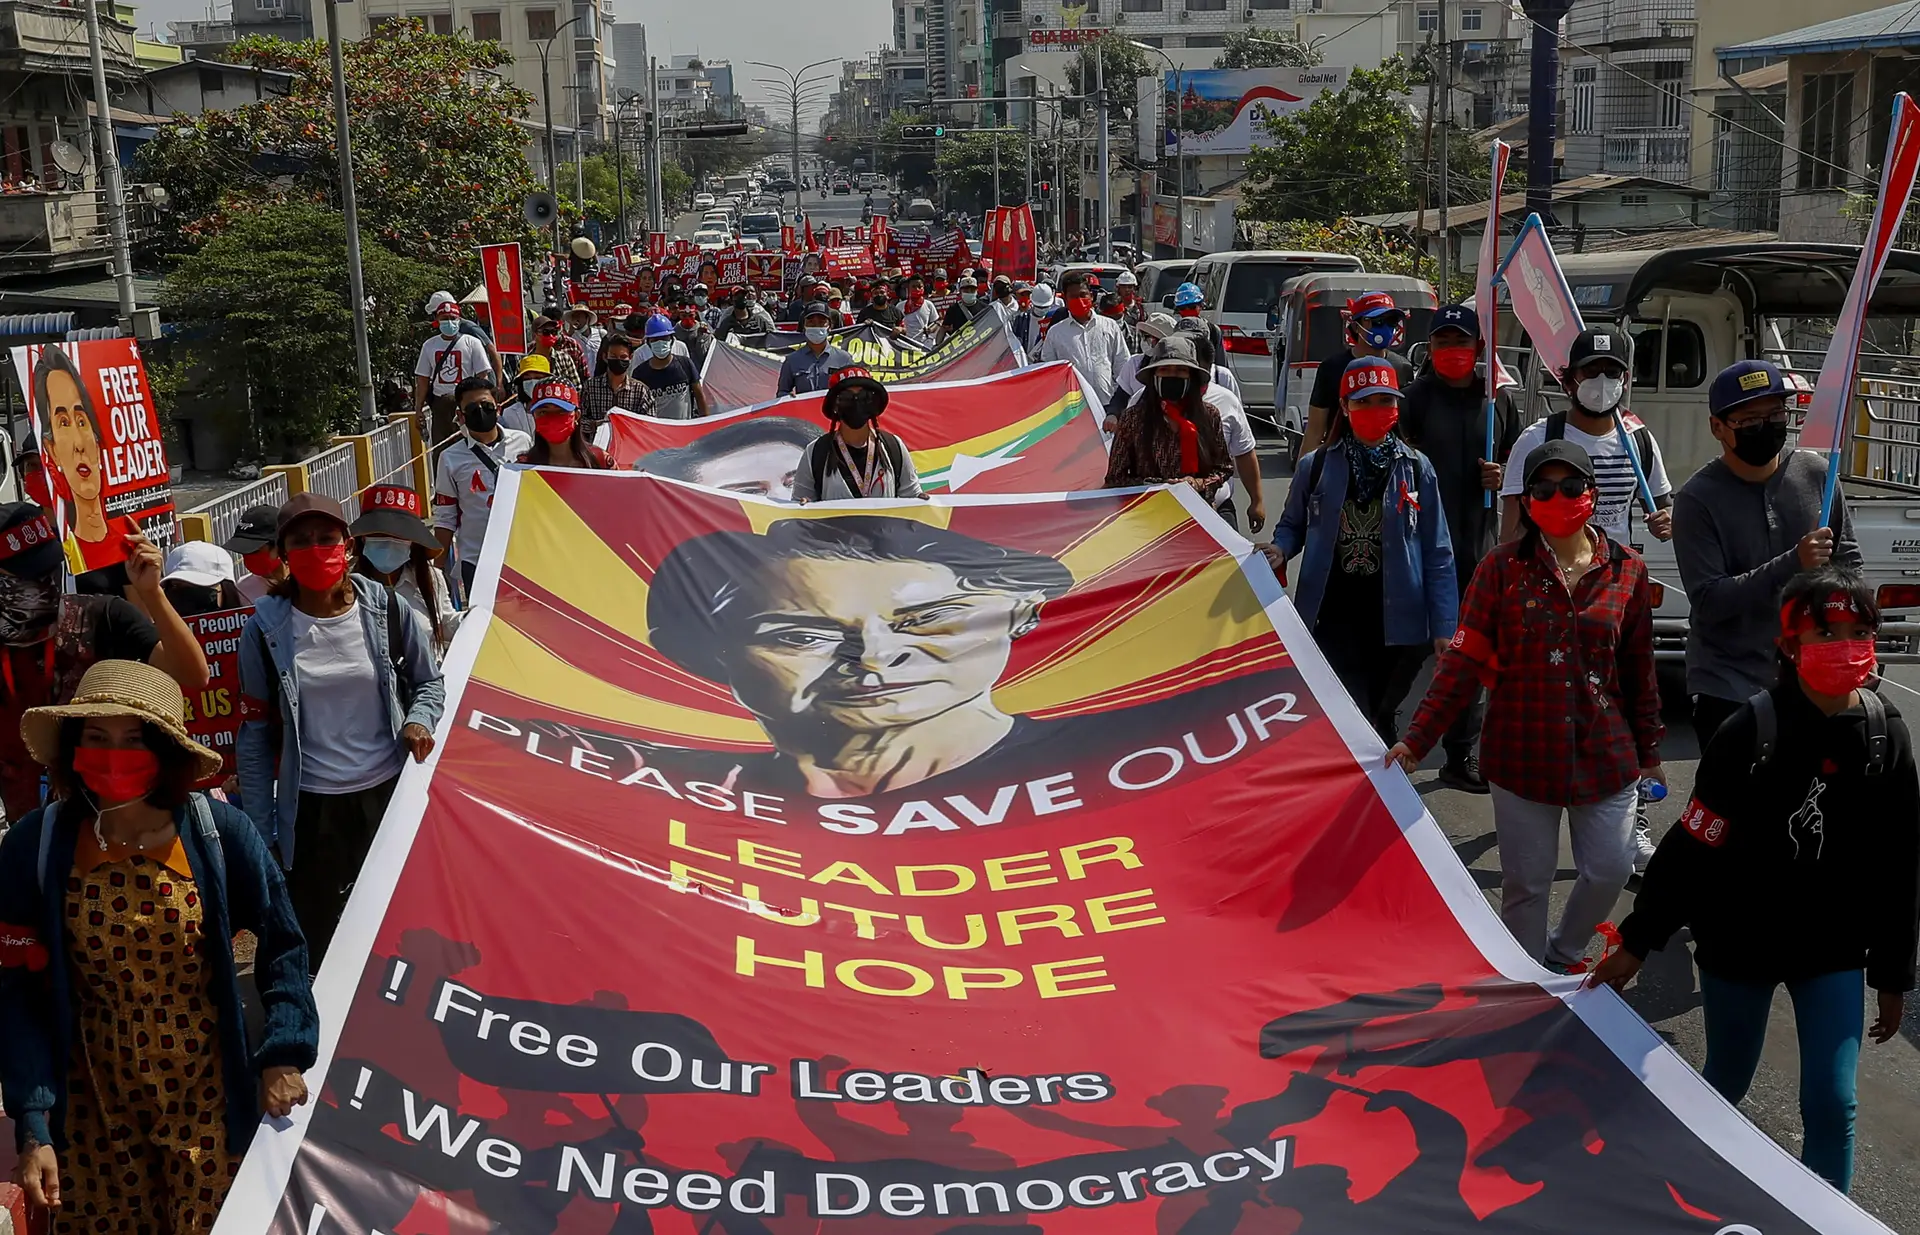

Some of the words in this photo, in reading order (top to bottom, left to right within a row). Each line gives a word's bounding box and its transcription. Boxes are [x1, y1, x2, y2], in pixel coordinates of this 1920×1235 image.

[717, 275, 746, 285] LEADER
[723, 262, 741, 271] FREE
[724, 270, 741, 279] OUR
[98, 365, 143, 405] FREE
[110, 403, 150, 444] OUR
[102, 439, 167, 486] LEADER
[199, 612, 249, 635] People
[208, 660, 221, 678] at
[201, 688, 232, 718] US
[215, 730, 233, 747] on
[467, 709, 787, 825] PLEASE
[817, 771, 1083, 836] SAVE
[1108, 692, 1307, 791] OUR
[668, 819, 1144, 897] LEADER
[668, 860, 1166, 950] FUTURE
[735, 935, 1116, 1000] HOPE
[433, 980, 599, 1068] Free
[631, 1042, 768, 1094] Our
[798, 1061, 1110, 1105] Leaders
[402, 1088, 522, 1178] We
[556, 1145, 776, 1214] Need
[815, 1138, 1289, 1217] Democracy
